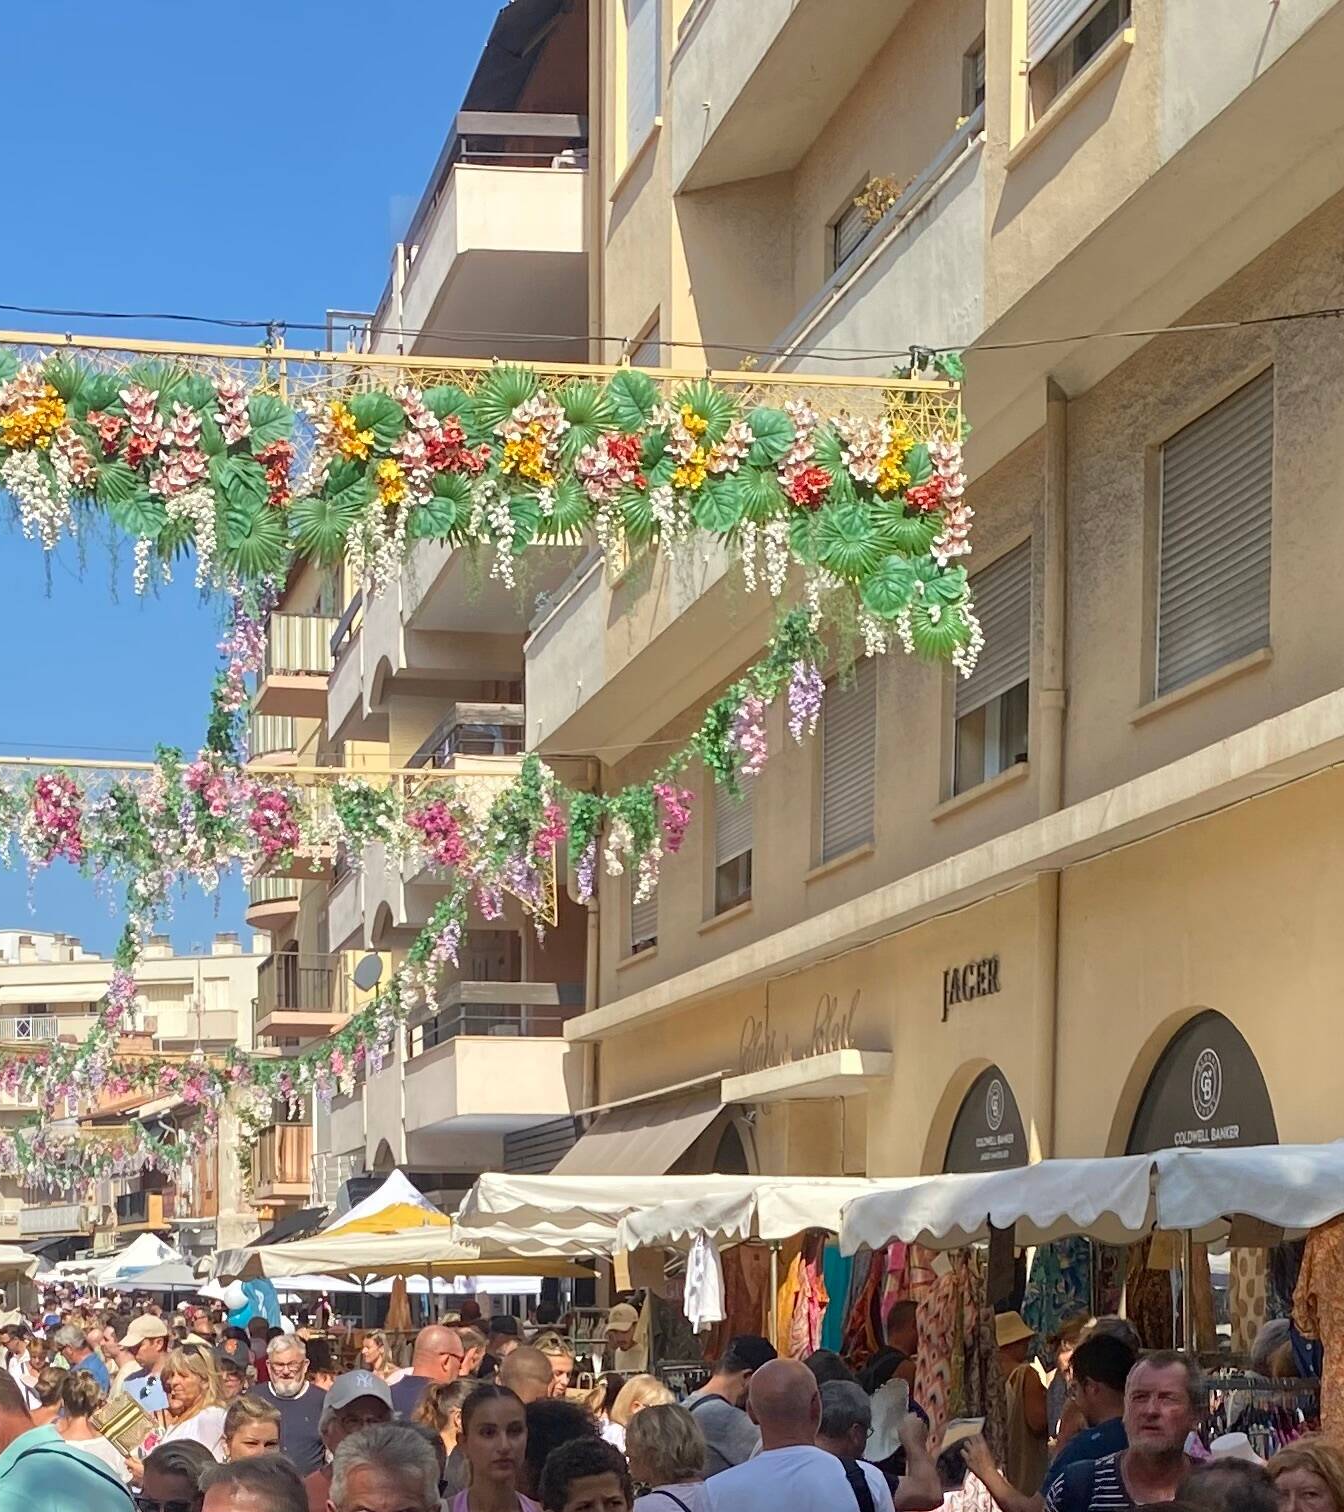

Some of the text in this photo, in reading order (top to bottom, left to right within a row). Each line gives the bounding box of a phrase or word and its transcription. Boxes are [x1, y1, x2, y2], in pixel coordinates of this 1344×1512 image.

[941, 954, 1001, 1022] JAGER
[1174, 1125, 1239, 1144] COLDWELL BANKER
